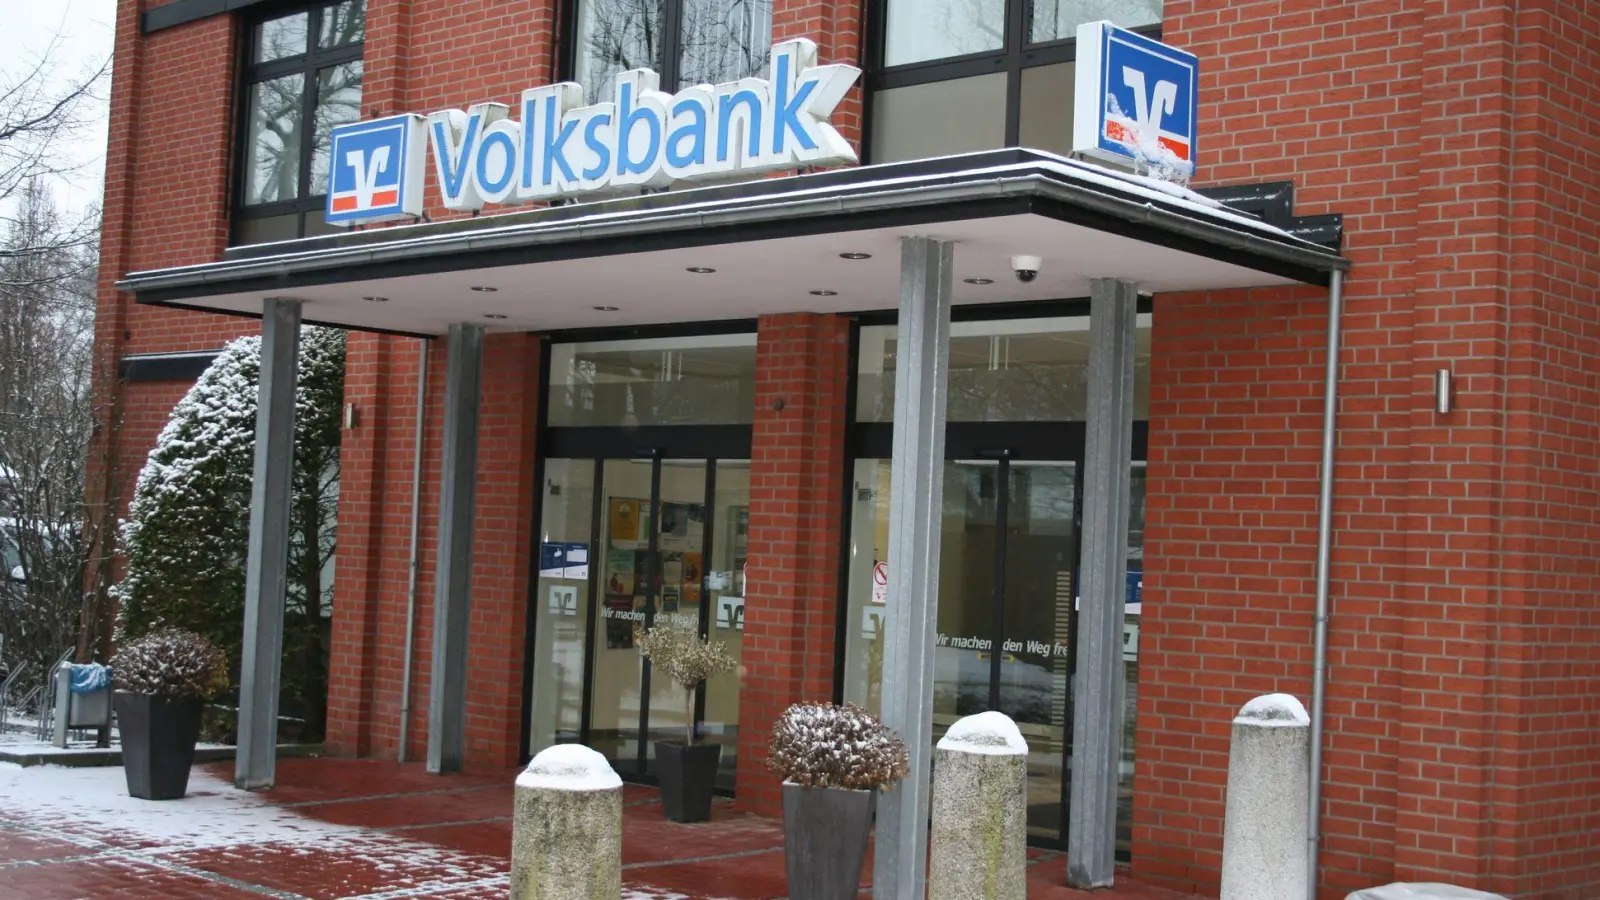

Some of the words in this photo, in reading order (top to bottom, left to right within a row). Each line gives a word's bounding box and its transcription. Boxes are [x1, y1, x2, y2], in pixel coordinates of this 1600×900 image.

[426, 50, 826, 203] Volksbank
[615, 608, 645, 621] machen
[653, 611, 669, 623] den
[951, 635, 992, 650] machen
[1002, 638, 1023, 652] den
[1026, 640, 1050, 657] Weg
